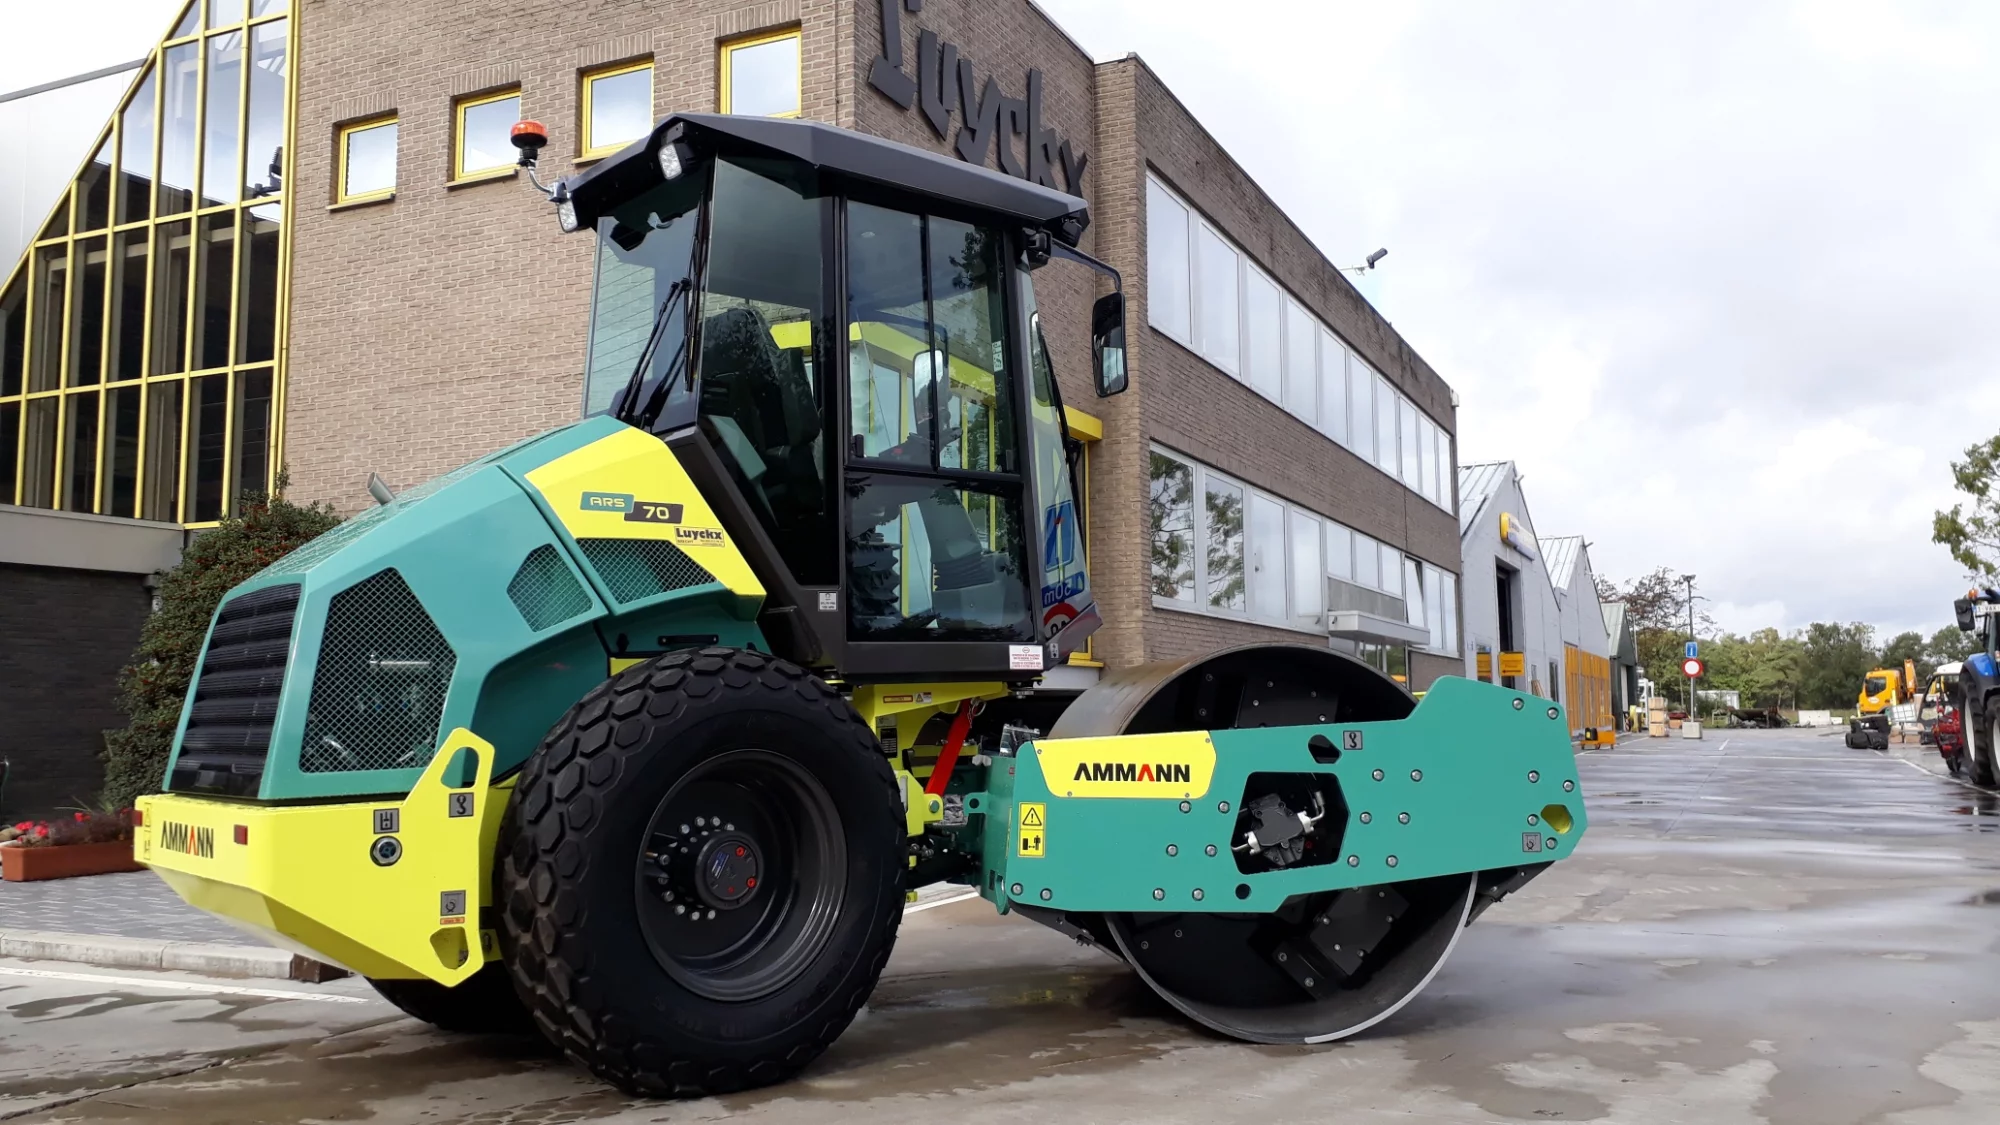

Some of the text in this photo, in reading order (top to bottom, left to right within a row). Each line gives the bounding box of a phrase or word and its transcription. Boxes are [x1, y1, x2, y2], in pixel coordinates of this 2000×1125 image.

[590, 496, 625, 508] ARS
[642, 505, 670, 520] 70
[675, 527, 722, 540] Luyckx
[1074, 763, 1190, 782] AMMANN
[160, 820, 214, 859] AMMANN
